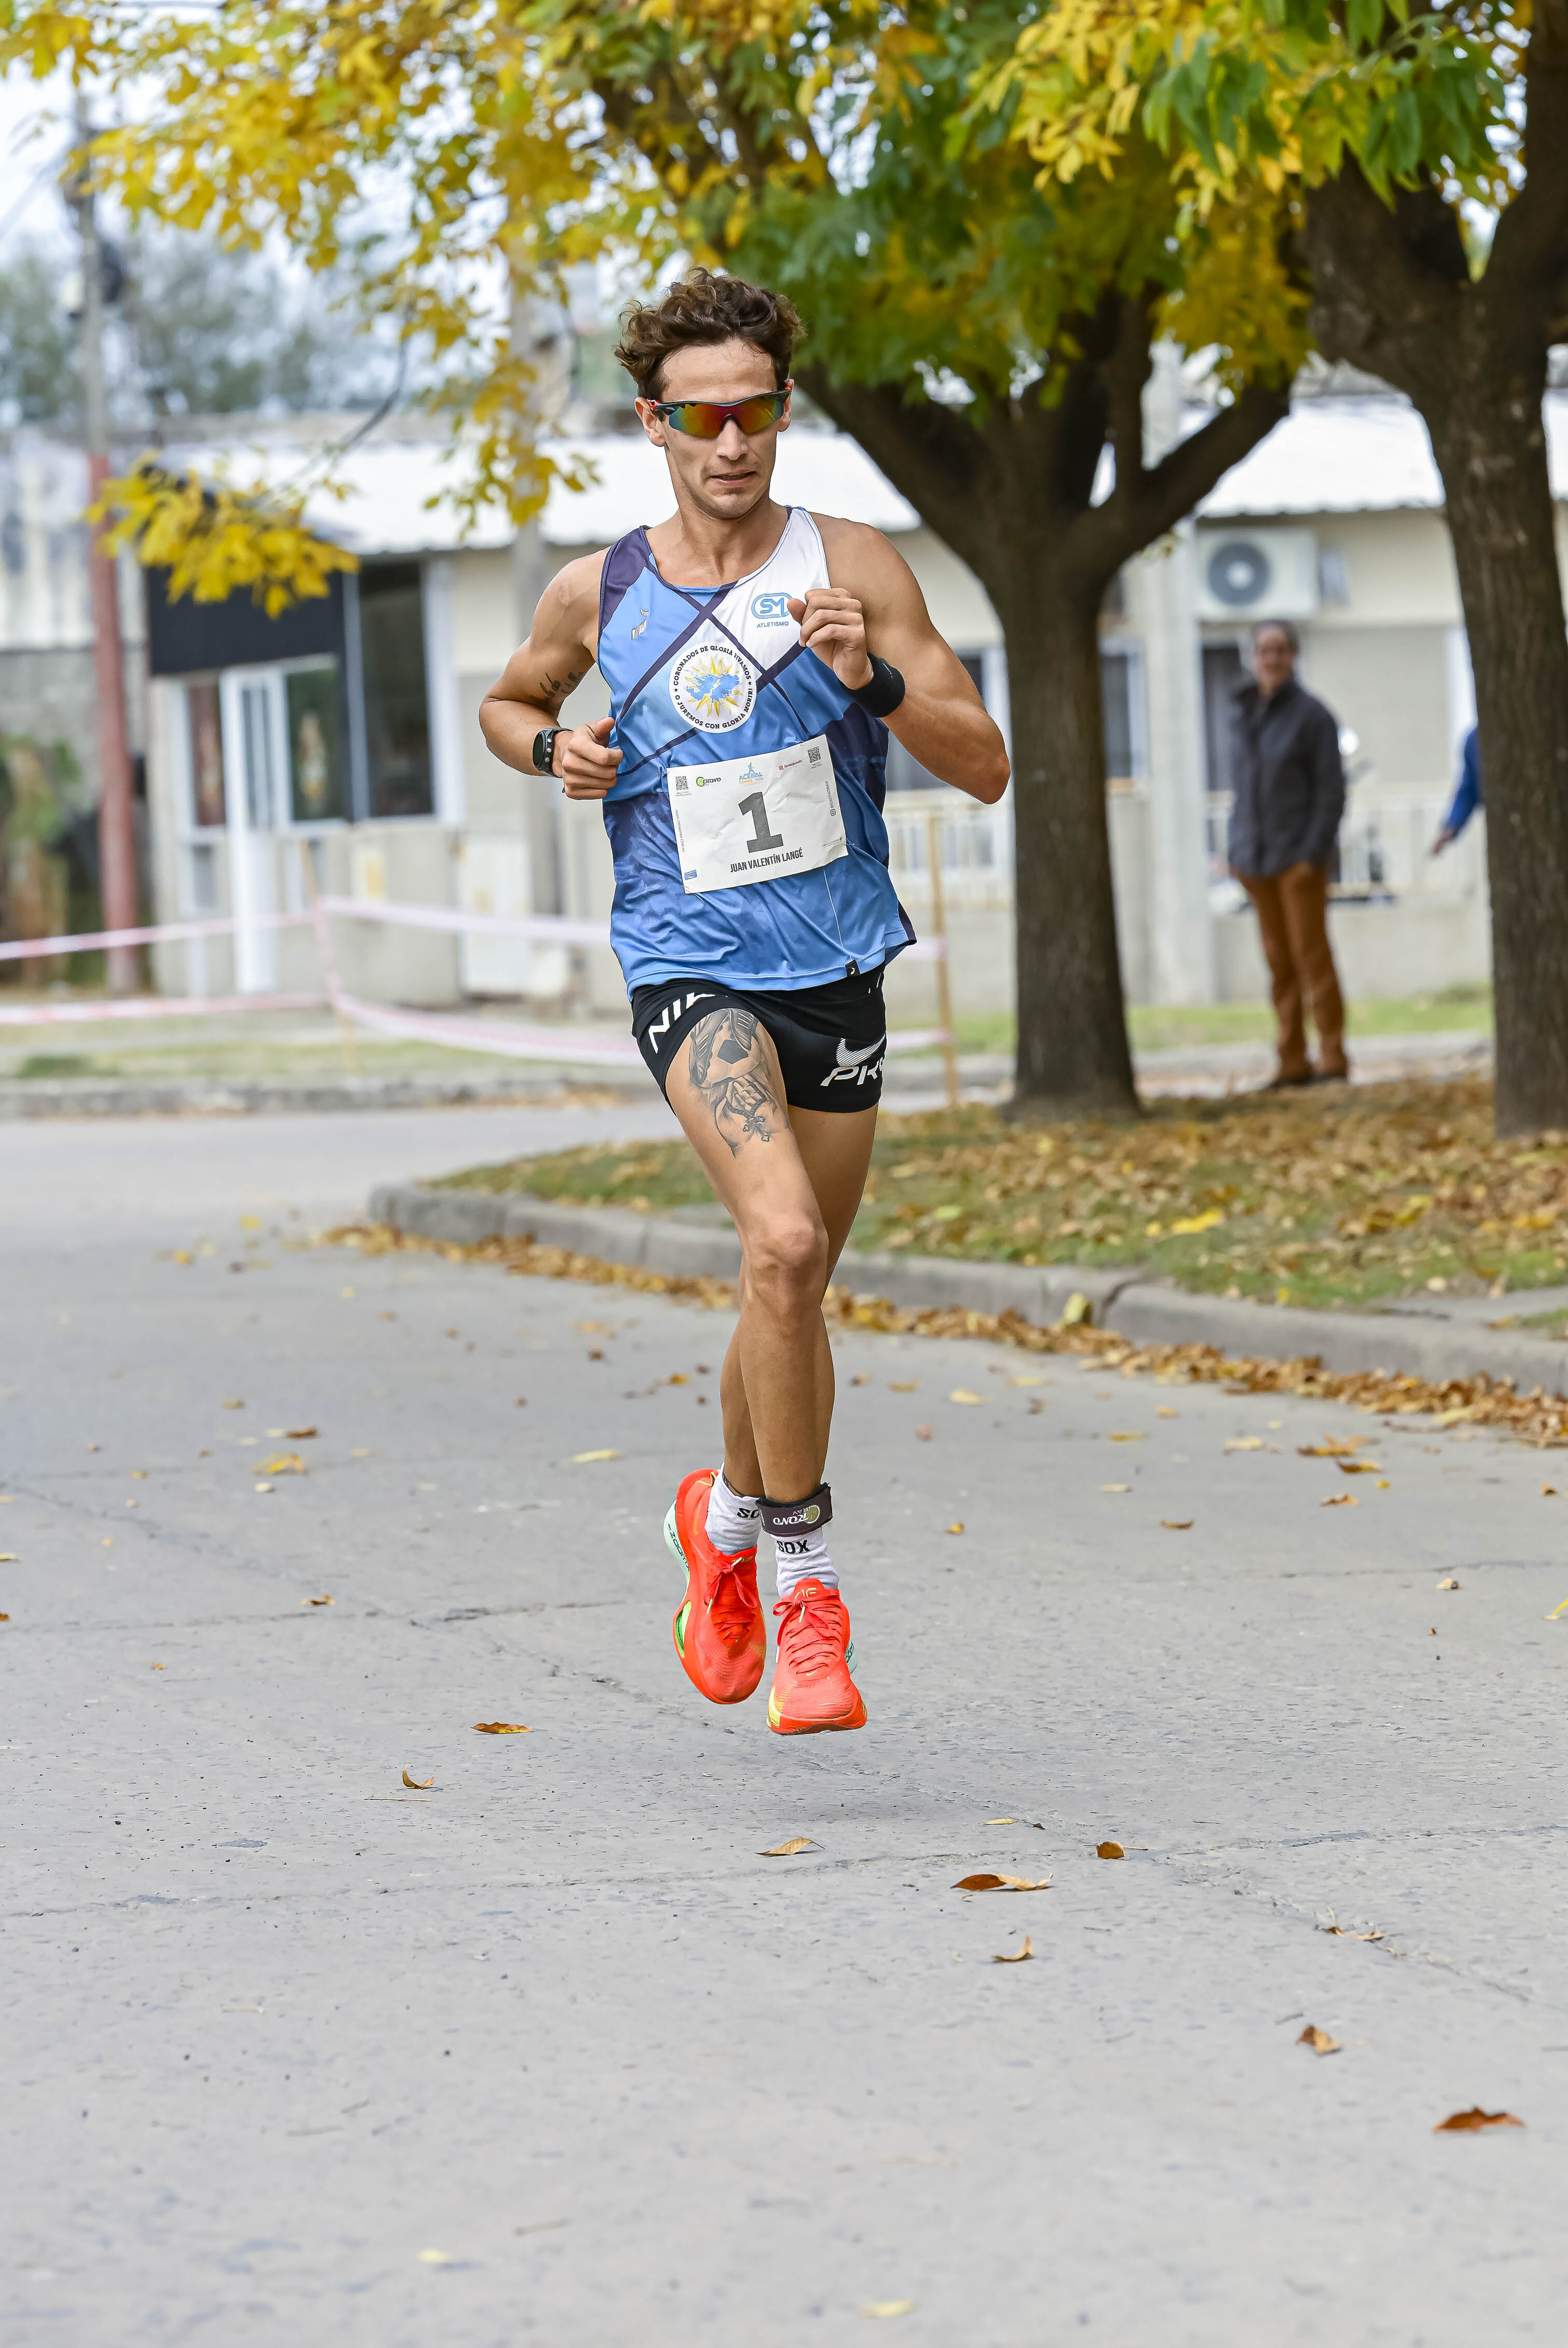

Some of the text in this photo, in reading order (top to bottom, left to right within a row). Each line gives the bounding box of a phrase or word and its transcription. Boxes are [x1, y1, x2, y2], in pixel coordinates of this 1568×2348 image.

[760, 597, 784, 617] SM
[674, 649, 699, 686] CORONADOS
[710, 645, 733, 656] GLORIA
[734, 652, 751, 680] VIVAMOS
[677, 702, 704, 726] JUREMOS
[722, 713, 746, 728] GLORIA
[739, 772, 763, 781] ACEBAL
[738, 792, 784, 854] 1
[730, 847, 804, 872] JUAN VALENTÍN LANGÉ
[648, 992, 716, 1054] NIK
[736, 1507, 760, 1519] SO
[776, 1539, 810, 1555] SOX
